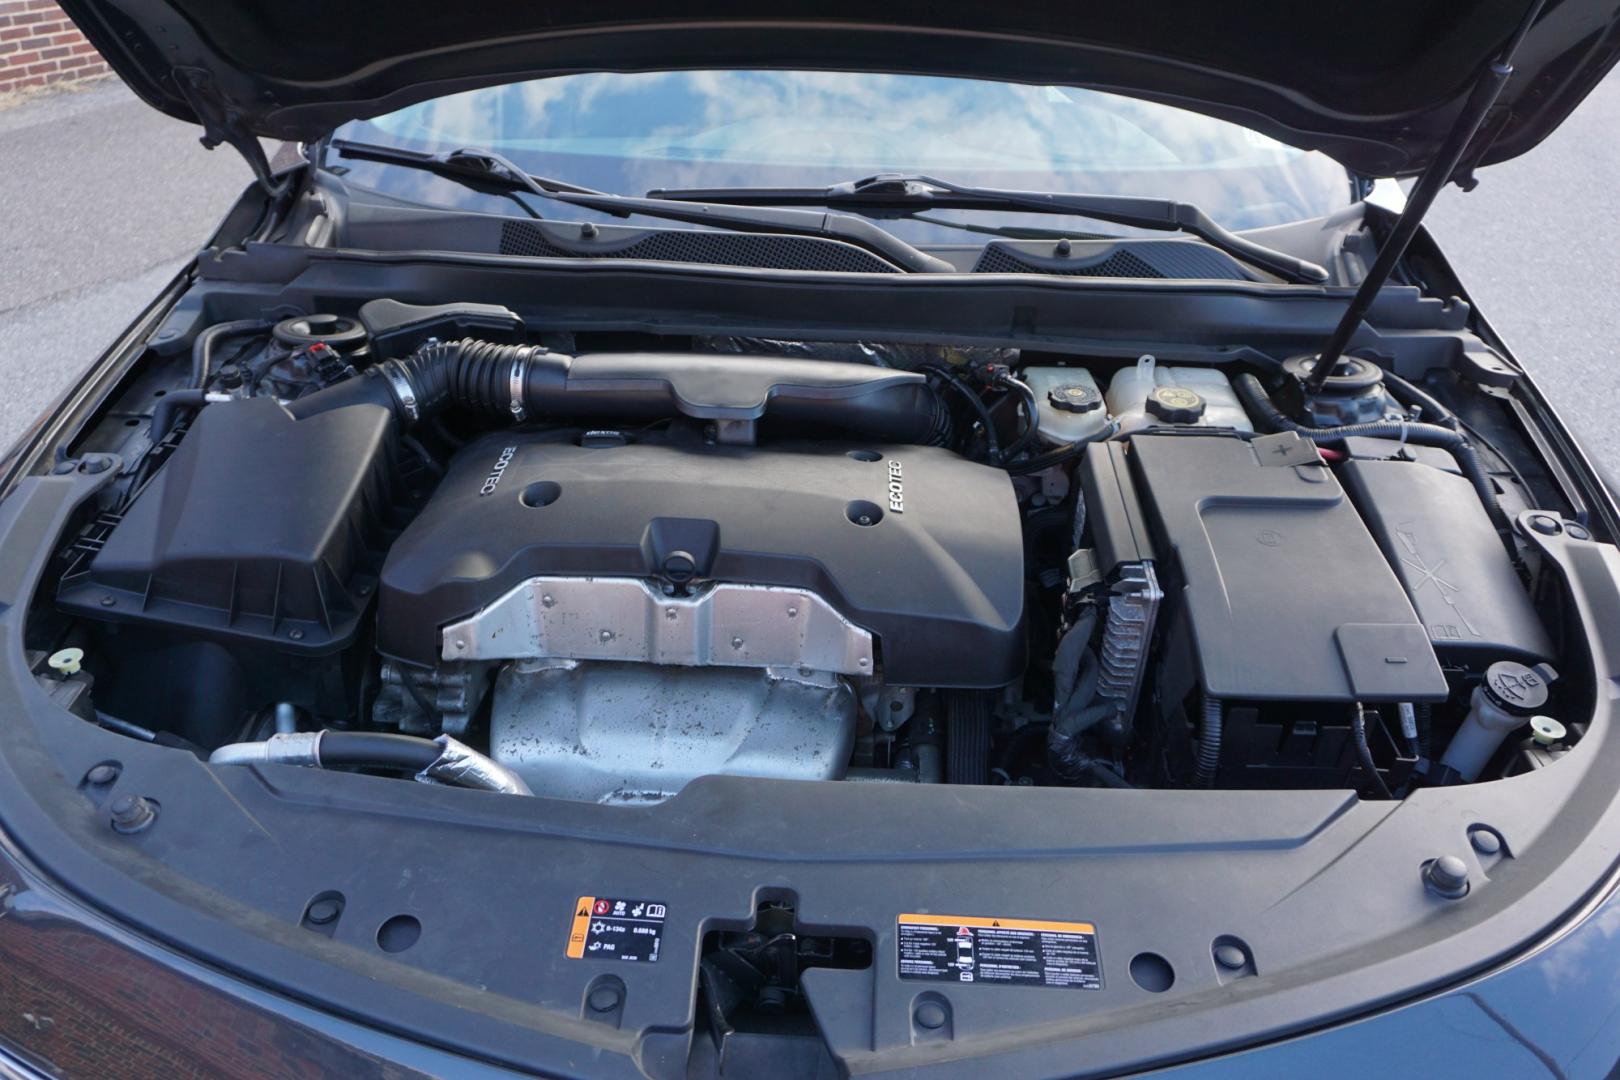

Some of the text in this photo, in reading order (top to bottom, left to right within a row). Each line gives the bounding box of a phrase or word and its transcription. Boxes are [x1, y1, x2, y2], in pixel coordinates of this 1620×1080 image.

[480, 445, 518, 496] ECOTEC
[888, 460, 904, 512] ECOTEC
[603, 943, 615, 951] PAG
